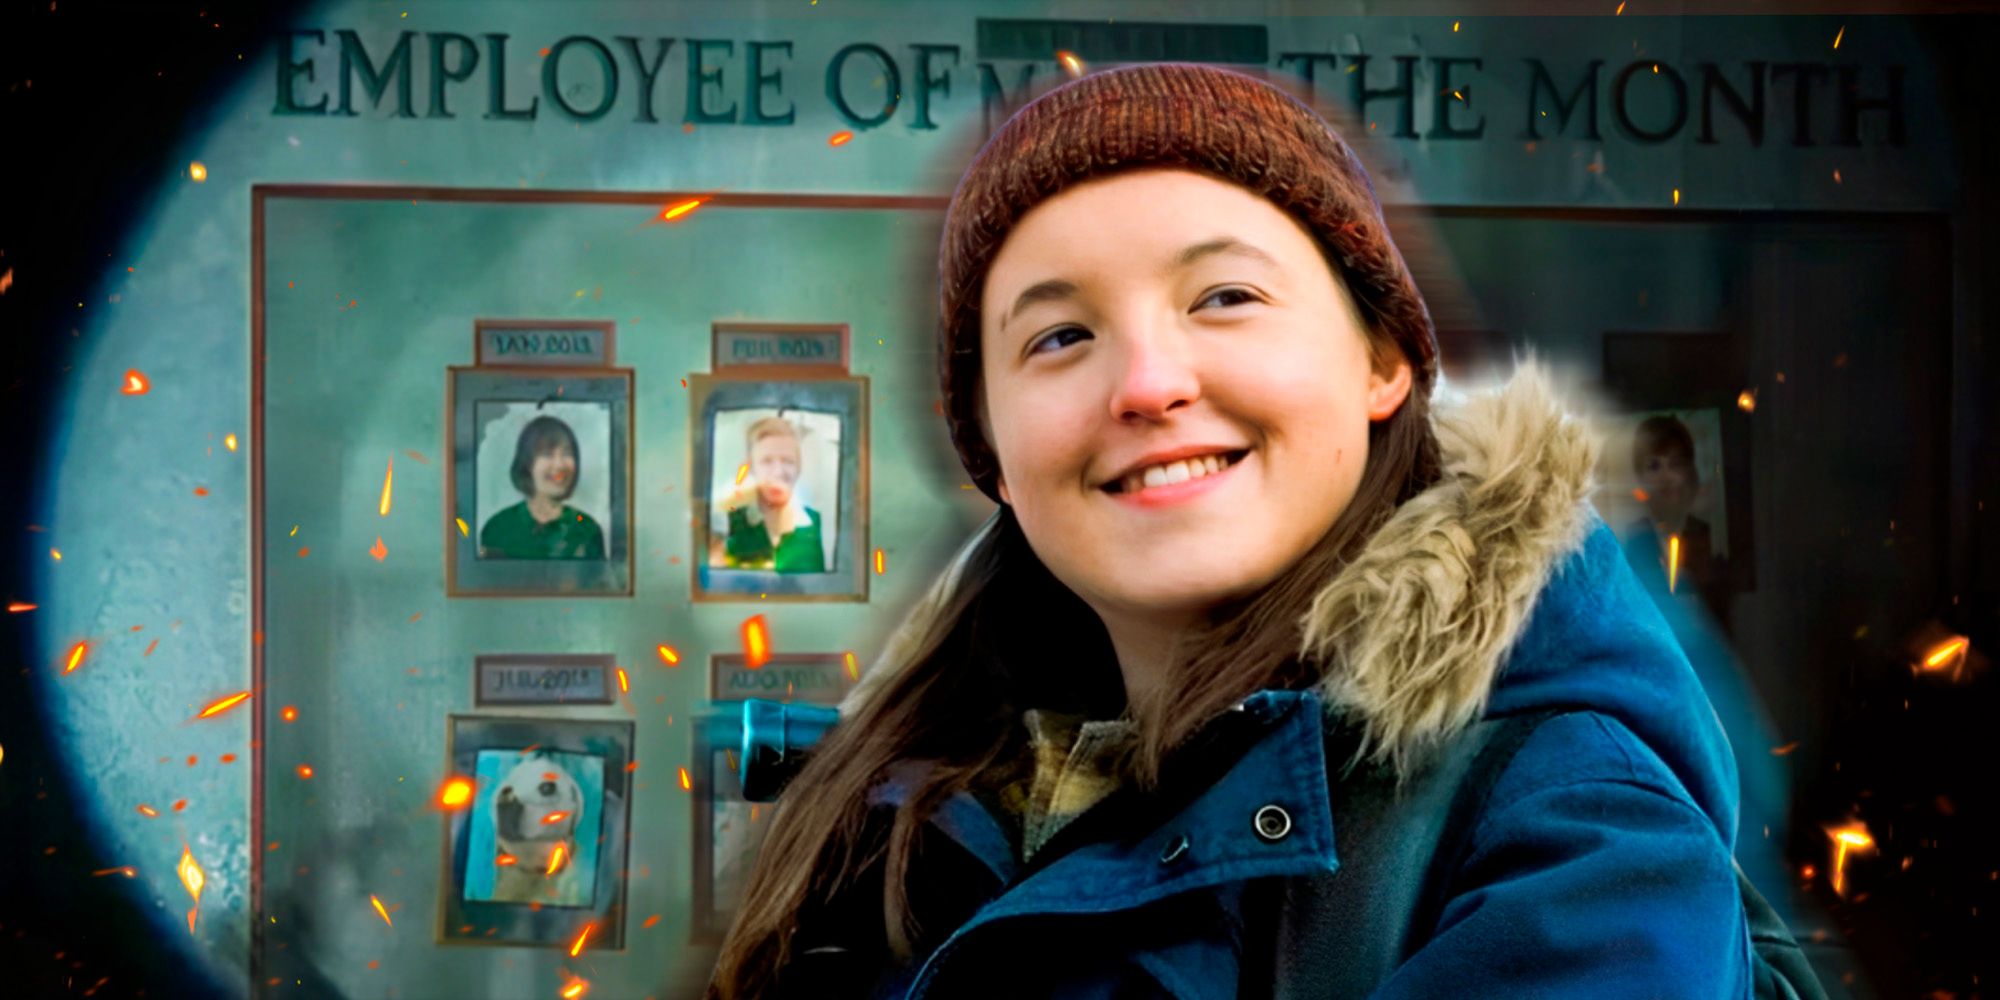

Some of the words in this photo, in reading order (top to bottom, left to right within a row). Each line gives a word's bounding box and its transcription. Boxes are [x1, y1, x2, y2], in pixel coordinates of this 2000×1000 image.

[271, 28, 796, 127] EMPLOYEE
[825, 42, 960, 130] OF
[1276, 52, 1486, 142] THE
[1521, 57, 1908, 149] MONTH
